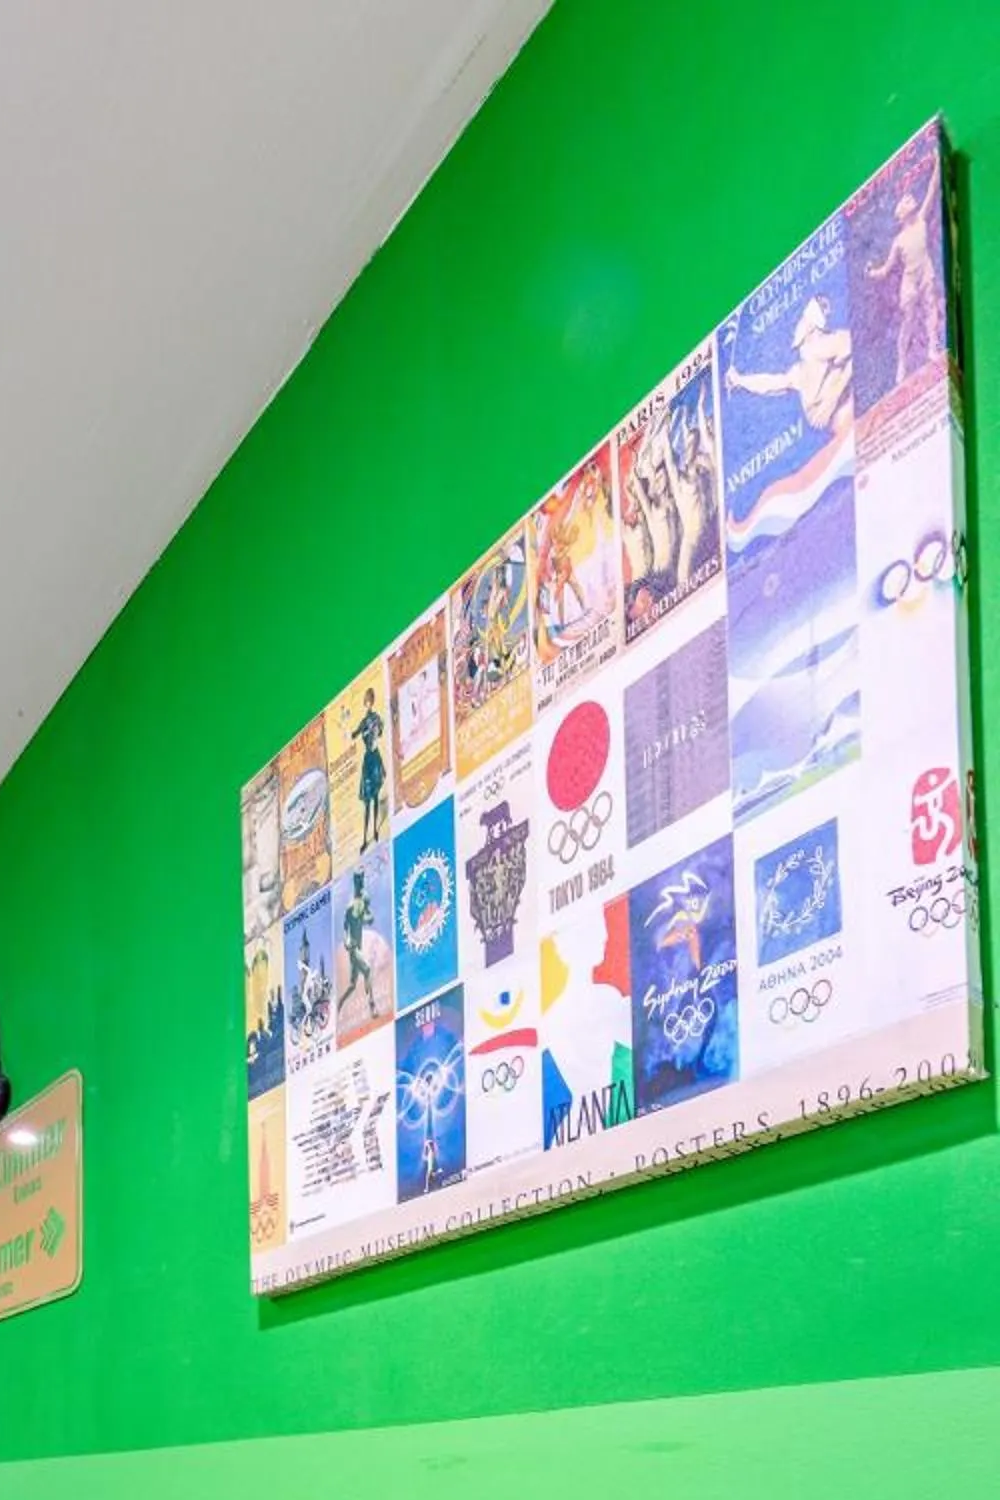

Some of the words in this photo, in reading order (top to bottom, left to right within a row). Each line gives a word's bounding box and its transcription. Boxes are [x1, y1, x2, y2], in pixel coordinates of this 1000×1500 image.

[615, 391, 666, 448] PARIS
[726, 416, 803, 493] AMSTERDAM
[548, 872, 583, 915] TOKYO
[588, 853, 615, 892] 1964
[885, 872, 943, 907] Beijing
[809, 945, 843, 972] 2004
[643, 976, 699, 1020] Sydney
[543, 1079, 633, 1151] ATLANTA
[250, 1273, 279, 1296] THE
[285, 1248, 352, 1284] OLYMPIC
[360, 1222, 434, 1261] MUSEUM
[445, 1171, 593, 1232] COLLECTION
[634, 1111, 772, 1173] POSTERS
